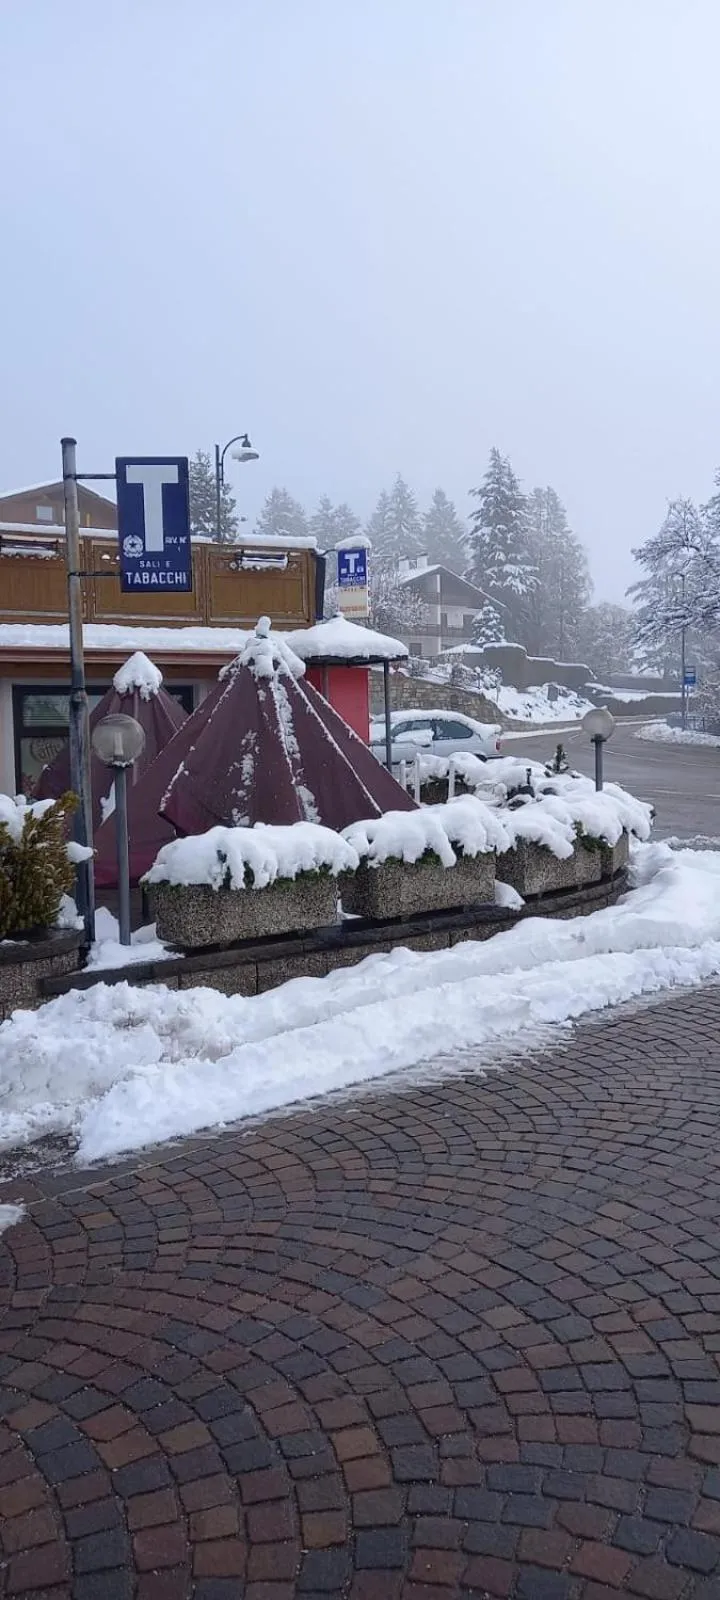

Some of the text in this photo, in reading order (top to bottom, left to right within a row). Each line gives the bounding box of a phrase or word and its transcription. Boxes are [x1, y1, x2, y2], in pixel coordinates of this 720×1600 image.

[126, 465, 178, 551] T
[139, 560, 160, 568] SALI
[344, 553, 359, 573] T
[126, 571, 186, 584] TABACCHI
